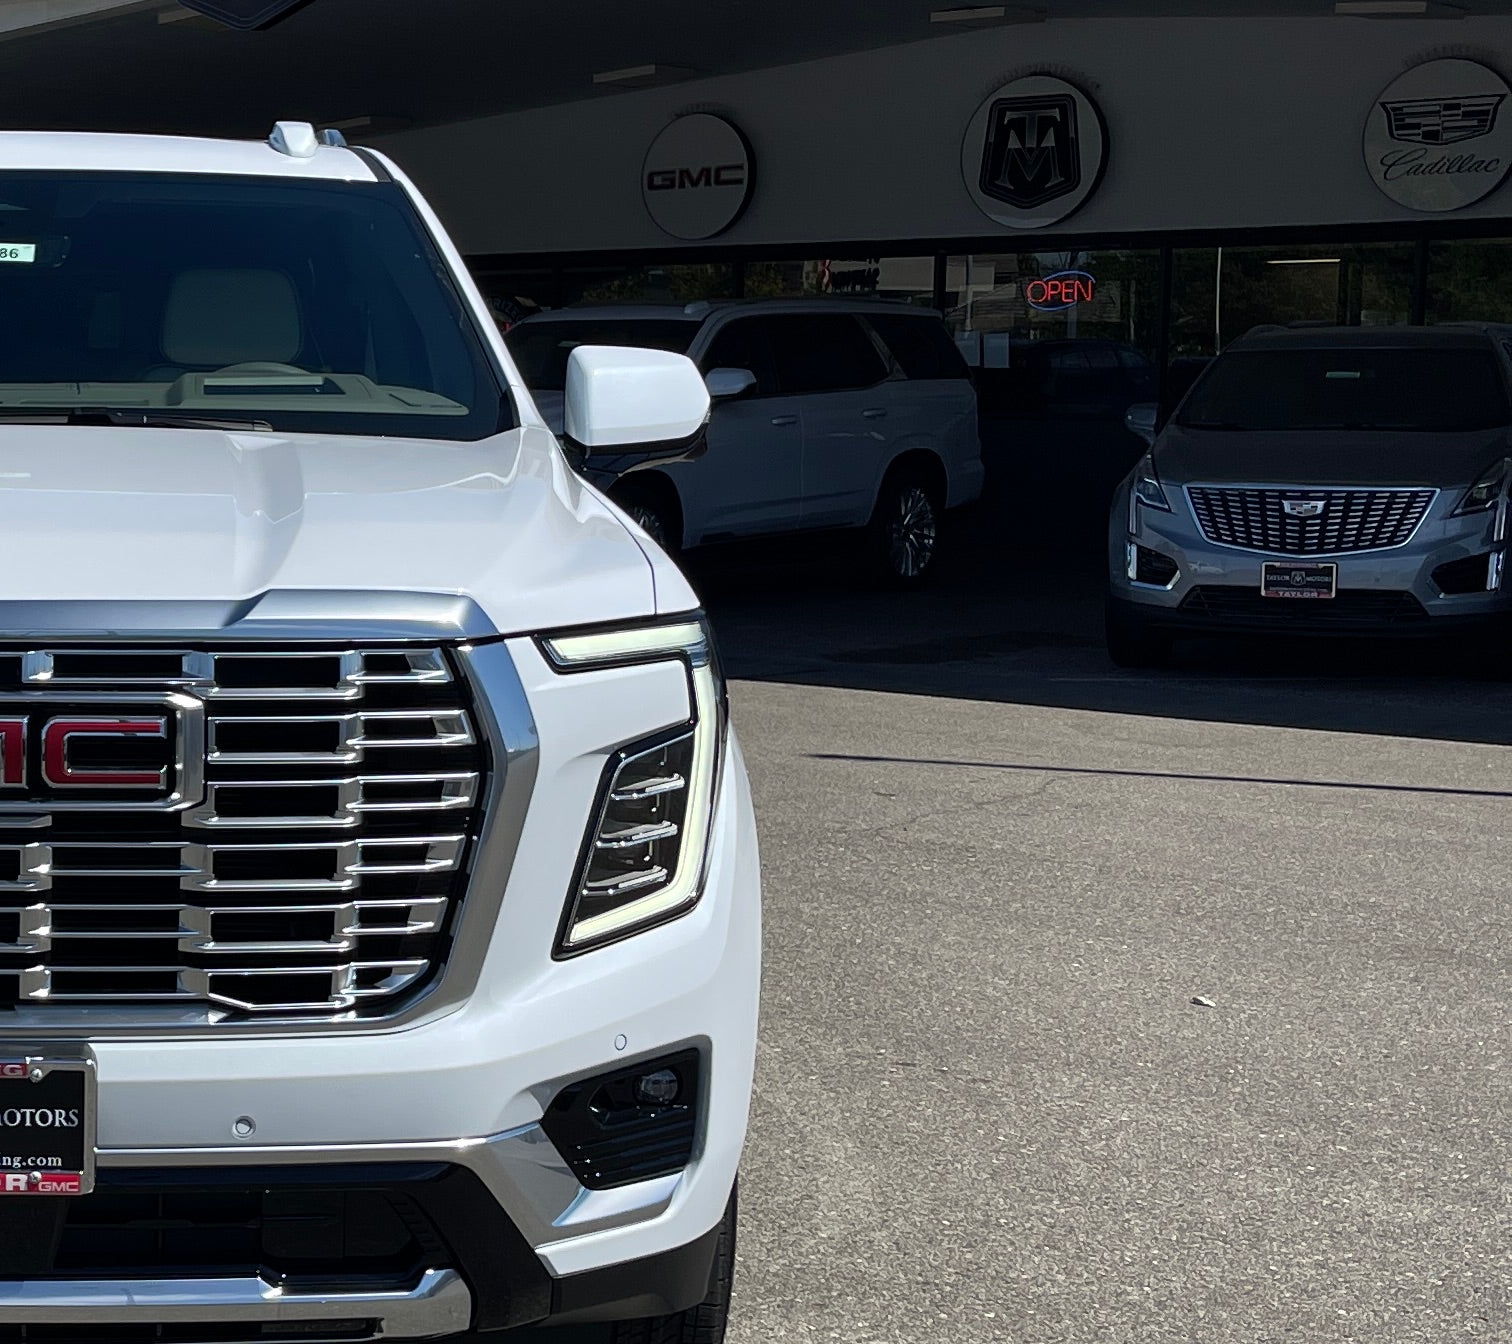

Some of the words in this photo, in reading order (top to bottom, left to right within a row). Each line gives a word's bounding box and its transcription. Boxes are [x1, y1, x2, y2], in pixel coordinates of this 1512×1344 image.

[647, 163, 744, 190] GMC
[1380, 148, 1500, 181] Cadillac
[1026, 280, 1093, 303] OPEN
[38, 1181, 79, 1192] GMC
